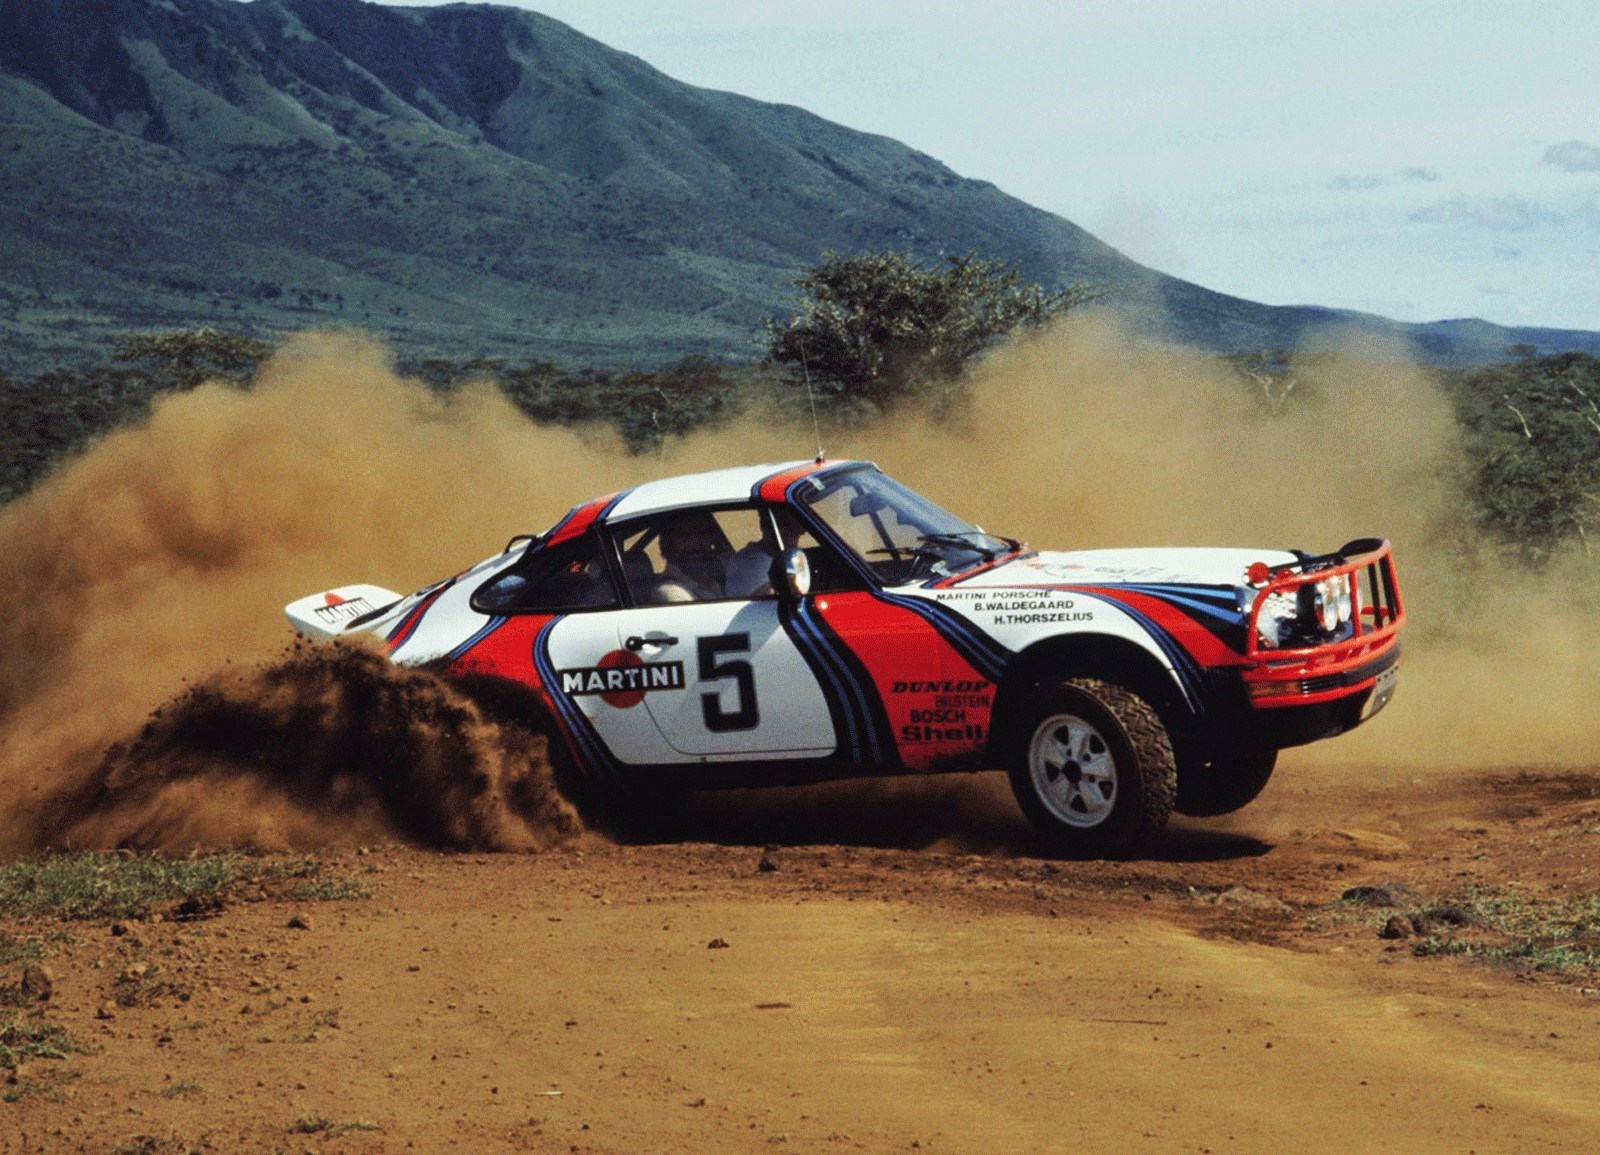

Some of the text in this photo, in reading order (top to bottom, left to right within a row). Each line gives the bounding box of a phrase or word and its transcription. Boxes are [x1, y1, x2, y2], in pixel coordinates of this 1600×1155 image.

[936, 590, 1051, 601] MARTINI PORSCHE
[974, 600, 1074, 611] B.WALDEGAARD
[994, 611, 1094, 624] H.THORSZELIUS
[562, 665, 680, 693] MARTINI
[697, 632, 760, 734] 5
[891, 681, 990, 693] DUNLOP
[911, 709, 966, 723] BOSCH
[901, 724, 984, 741] Shell
